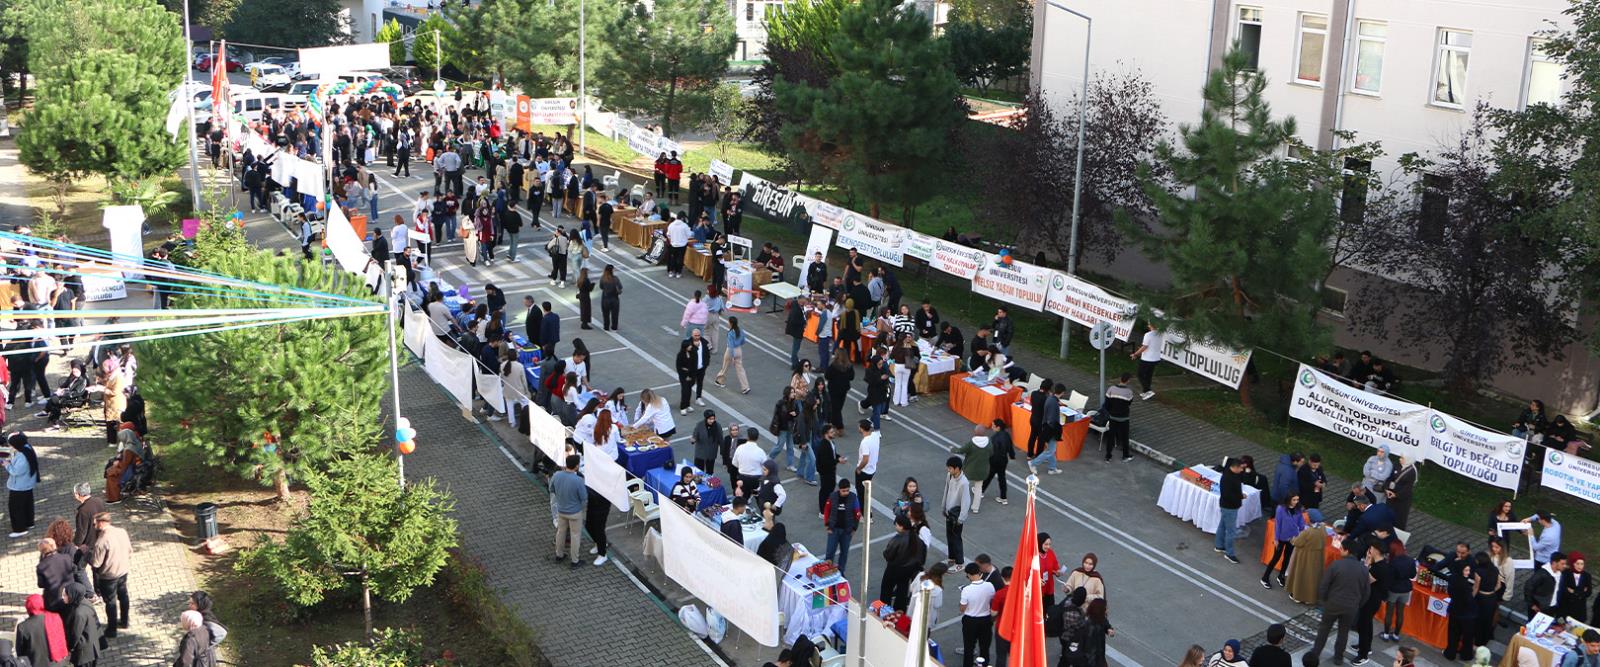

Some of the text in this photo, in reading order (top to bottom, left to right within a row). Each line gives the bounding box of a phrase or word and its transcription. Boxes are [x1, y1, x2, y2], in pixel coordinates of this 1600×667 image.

[1047, 299, 1071, 318] ÇOCUK
[1308, 391, 1411, 435] ALUCRA TOPLUMSAL
[1320, 382, 1401, 417] GİRESUN ÜNİVERSİTESİ
[1297, 397, 1420, 447] DUYARLILIK TOPLULUĞU
[1332, 422, 1374, 445] (TODUT)
[1430, 435, 1519, 475] BİLGİ VE DEĞERLER
[1442, 454, 1498, 483] TOPLULUĞU
